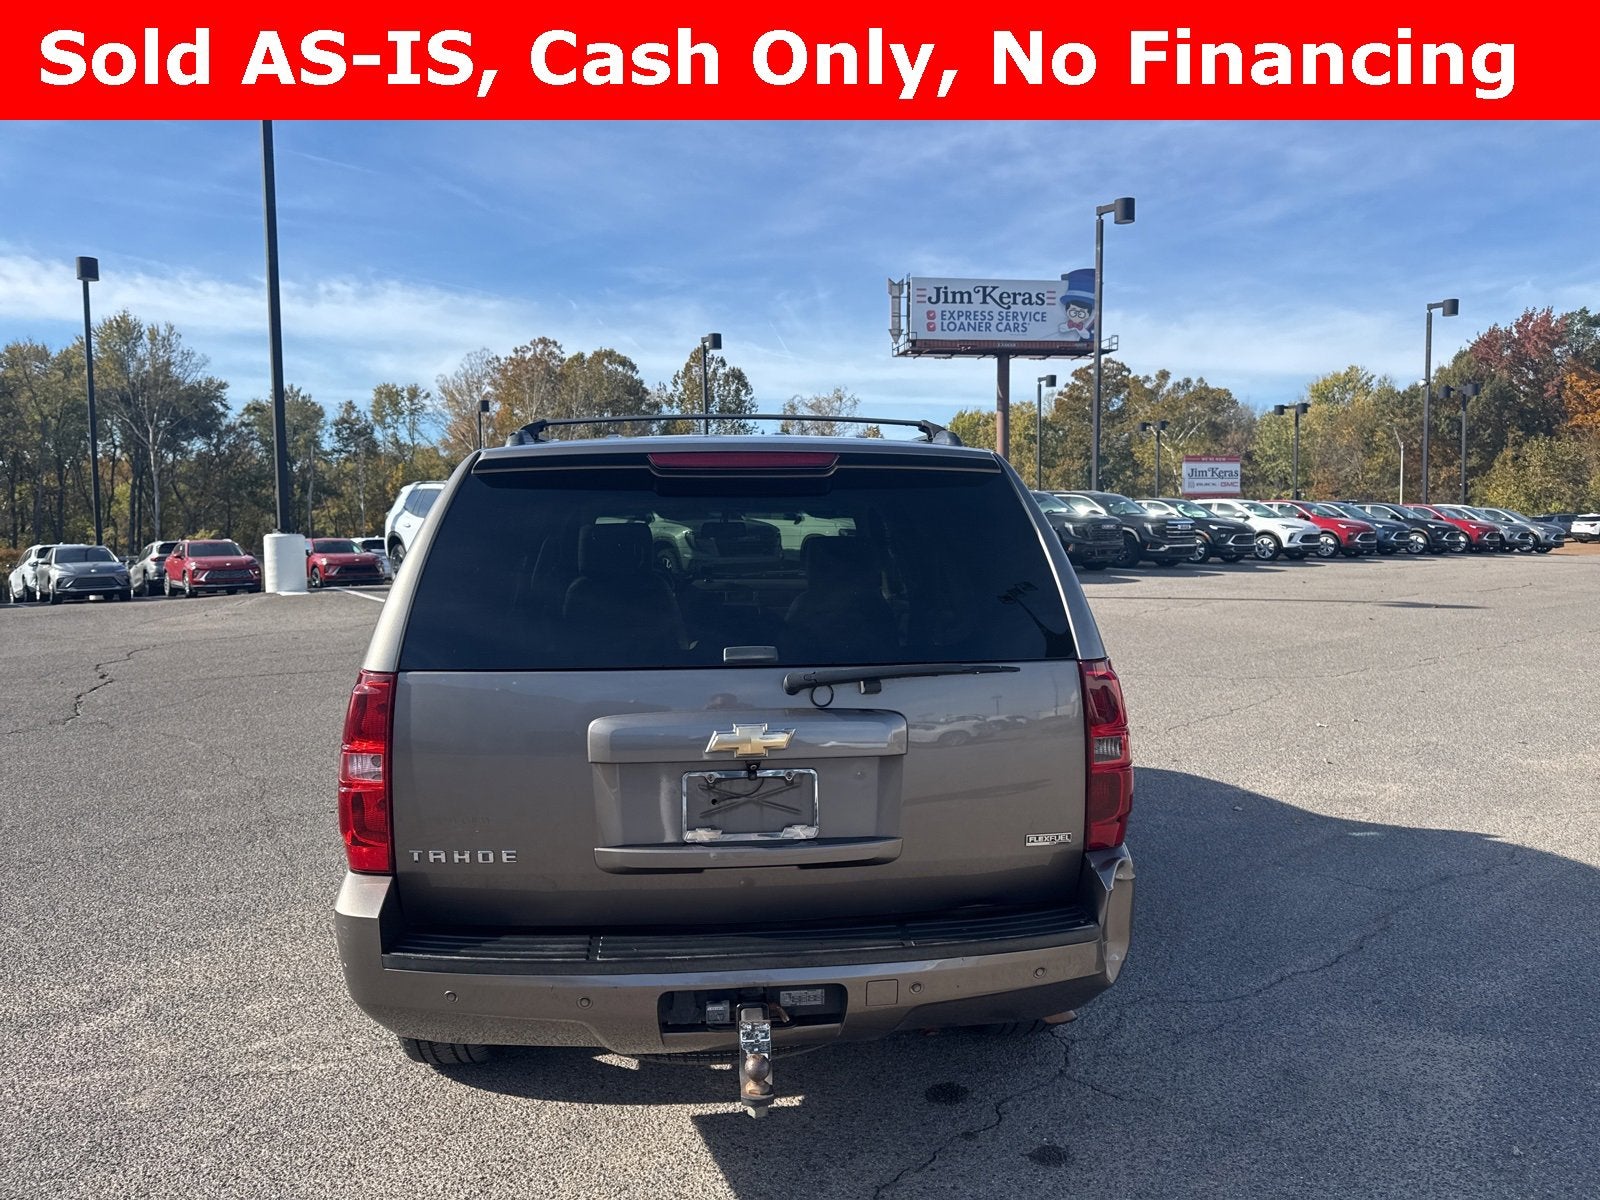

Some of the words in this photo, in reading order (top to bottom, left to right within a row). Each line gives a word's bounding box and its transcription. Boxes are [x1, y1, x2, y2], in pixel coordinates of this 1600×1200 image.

[928, 286, 973, 305] Jim
[973, 286, 1046, 310] Keras
[940, 310, 994, 321] EXPRESS
[997, 311, 1047, 322] SERVICE
[940, 322, 992, 332] LOANER
[1188, 468, 1207, 478] Jim
[1208, 467, 1239, 479] Keras
[408, 850, 517, 864] TAHOE
